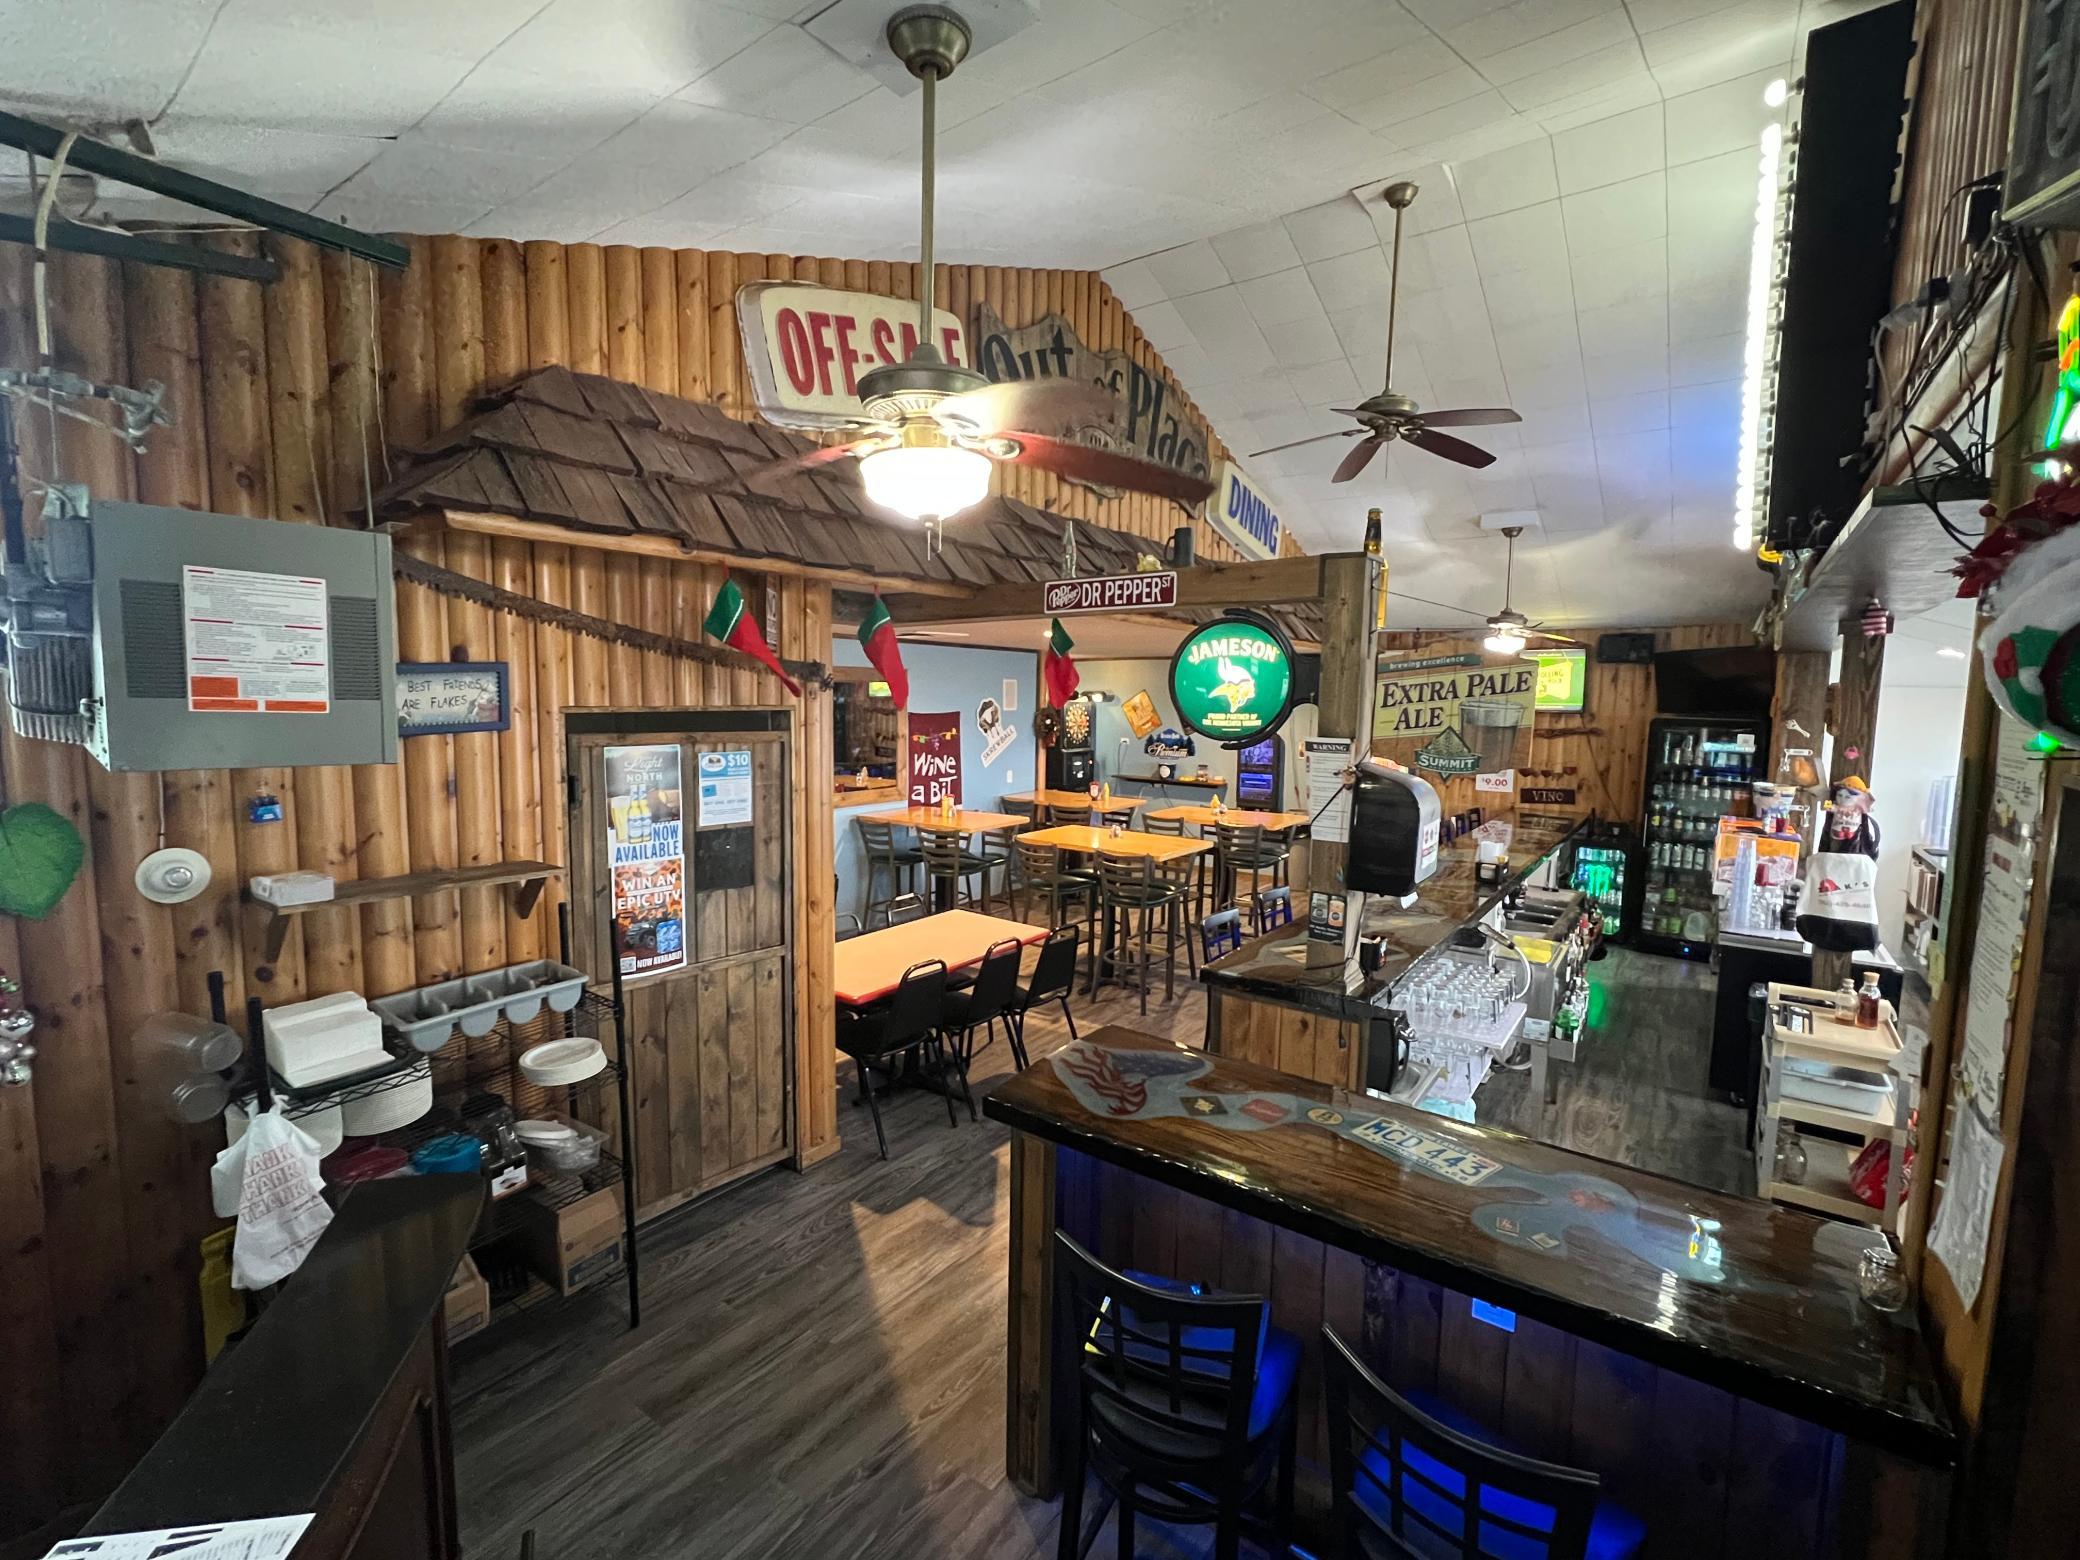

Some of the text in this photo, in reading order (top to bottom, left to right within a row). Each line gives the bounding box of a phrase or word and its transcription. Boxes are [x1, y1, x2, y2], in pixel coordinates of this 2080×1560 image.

[777, 308, 960, 396] OFF-SAE
[1229, 474, 1279, 556] DINING
[1049, 588, 1079, 608] Pepper
[1060, 585, 1072, 595] Dr
[1082, 577, 1172, 607] DR PEPPER ST
[1188, 638, 1278, 665] JAMESON
[1389, 655, 1465, 670] brewing excellence
[407, 678, 481, 692] BEST FRIENDS
[1381, 670, 1533, 708] EXTRA PALE
[402, 695, 468, 710] ARE FLAKES
[1393, 706, 1444, 731] ALE
[1312, 743, 1347, 751] WARNING
[727, 754, 749, 767] $10
[1418, 754, 1475, 769] SUMMIT
[626, 773, 663, 783] NORTH
[911, 785, 925, 803] a
[653, 824, 679, 843] NOW
[615, 840, 679, 864] AVAILABLE
[622, 873, 677, 891] WIN AN
[618, 890, 681, 910] EPIC UTV
[637, 958, 653, 969] NOW
[1363, 1121, 1424, 1149] MCD
[1424, 1148, 1490, 1177] 443
